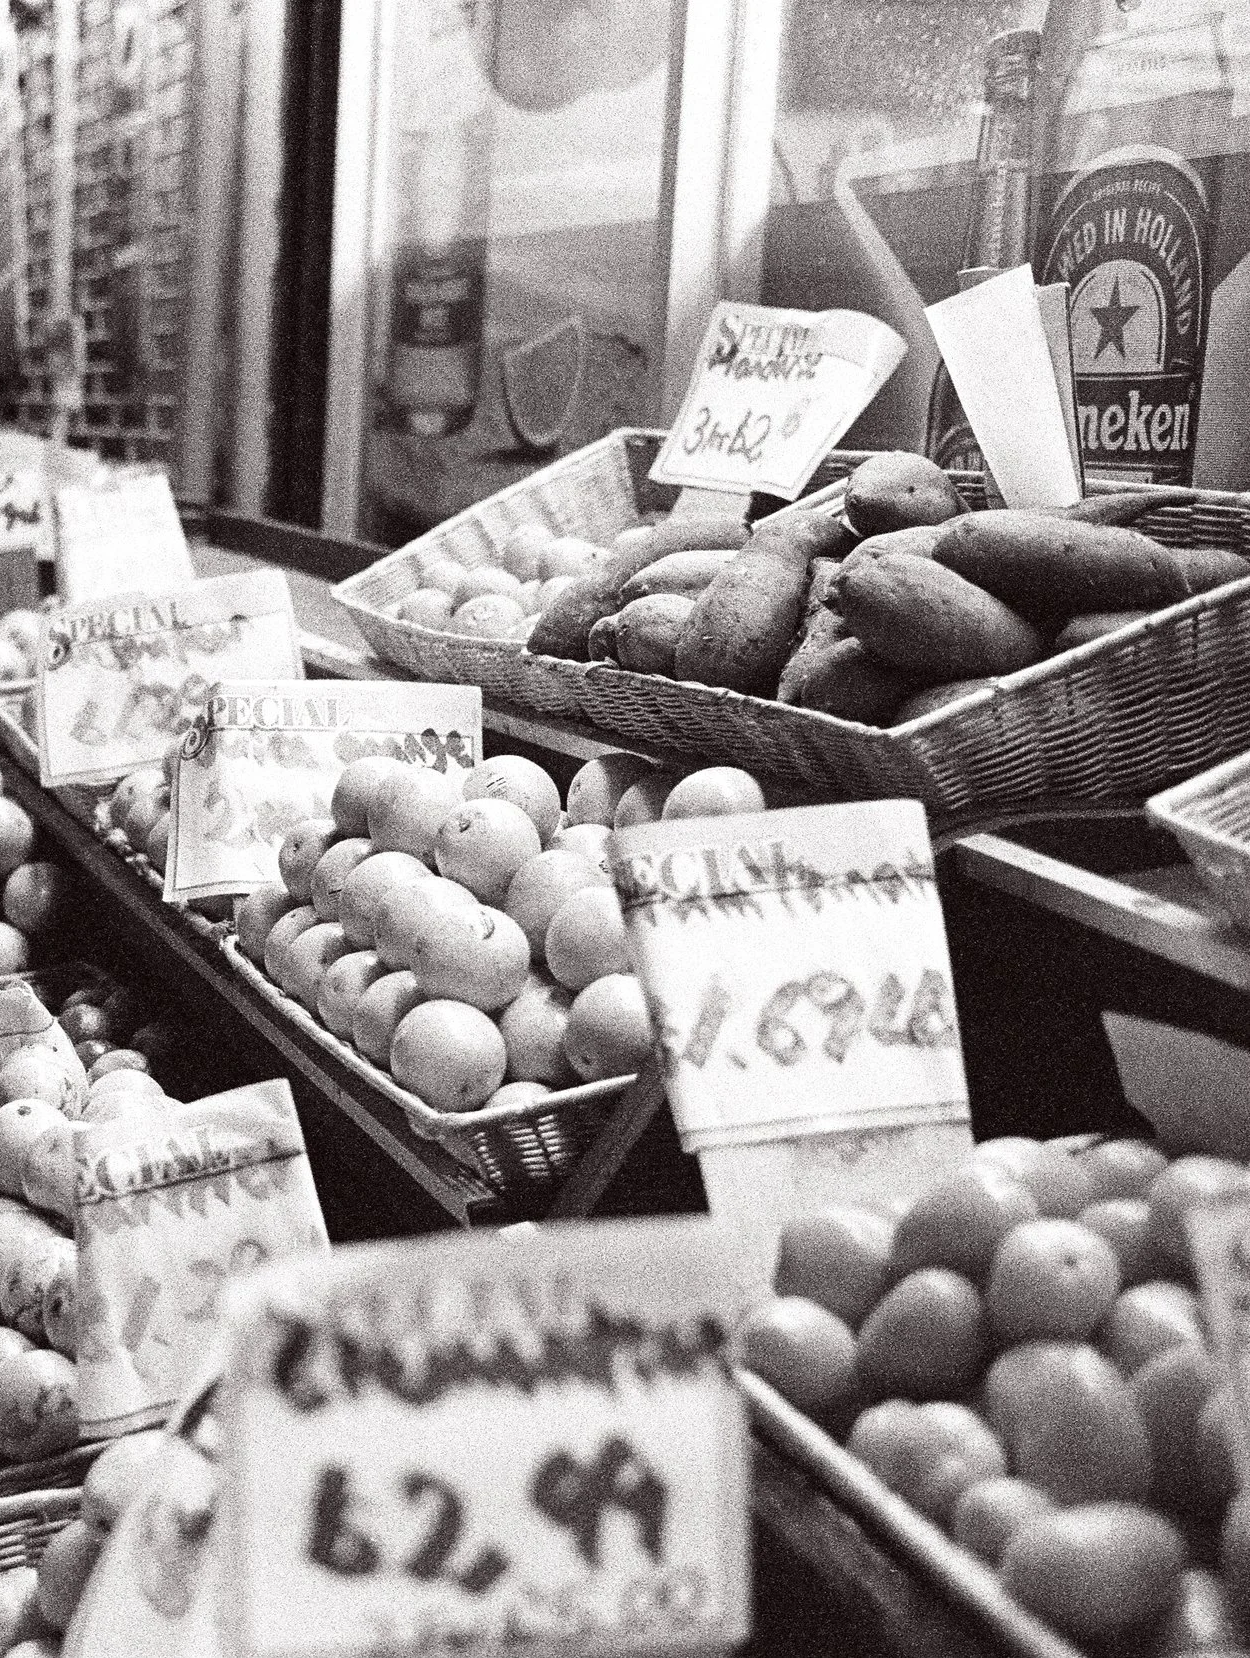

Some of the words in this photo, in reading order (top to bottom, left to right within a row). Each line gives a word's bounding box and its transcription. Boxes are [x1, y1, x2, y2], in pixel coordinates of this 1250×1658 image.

[1057, 221, 1097, 278] WED
[1104, 207, 1127, 244] IN
[1134, 206, 1193, 335] HOLLAND
[682, 406, 711, 455] 3
[1077, 390, 1191, 452] neken
